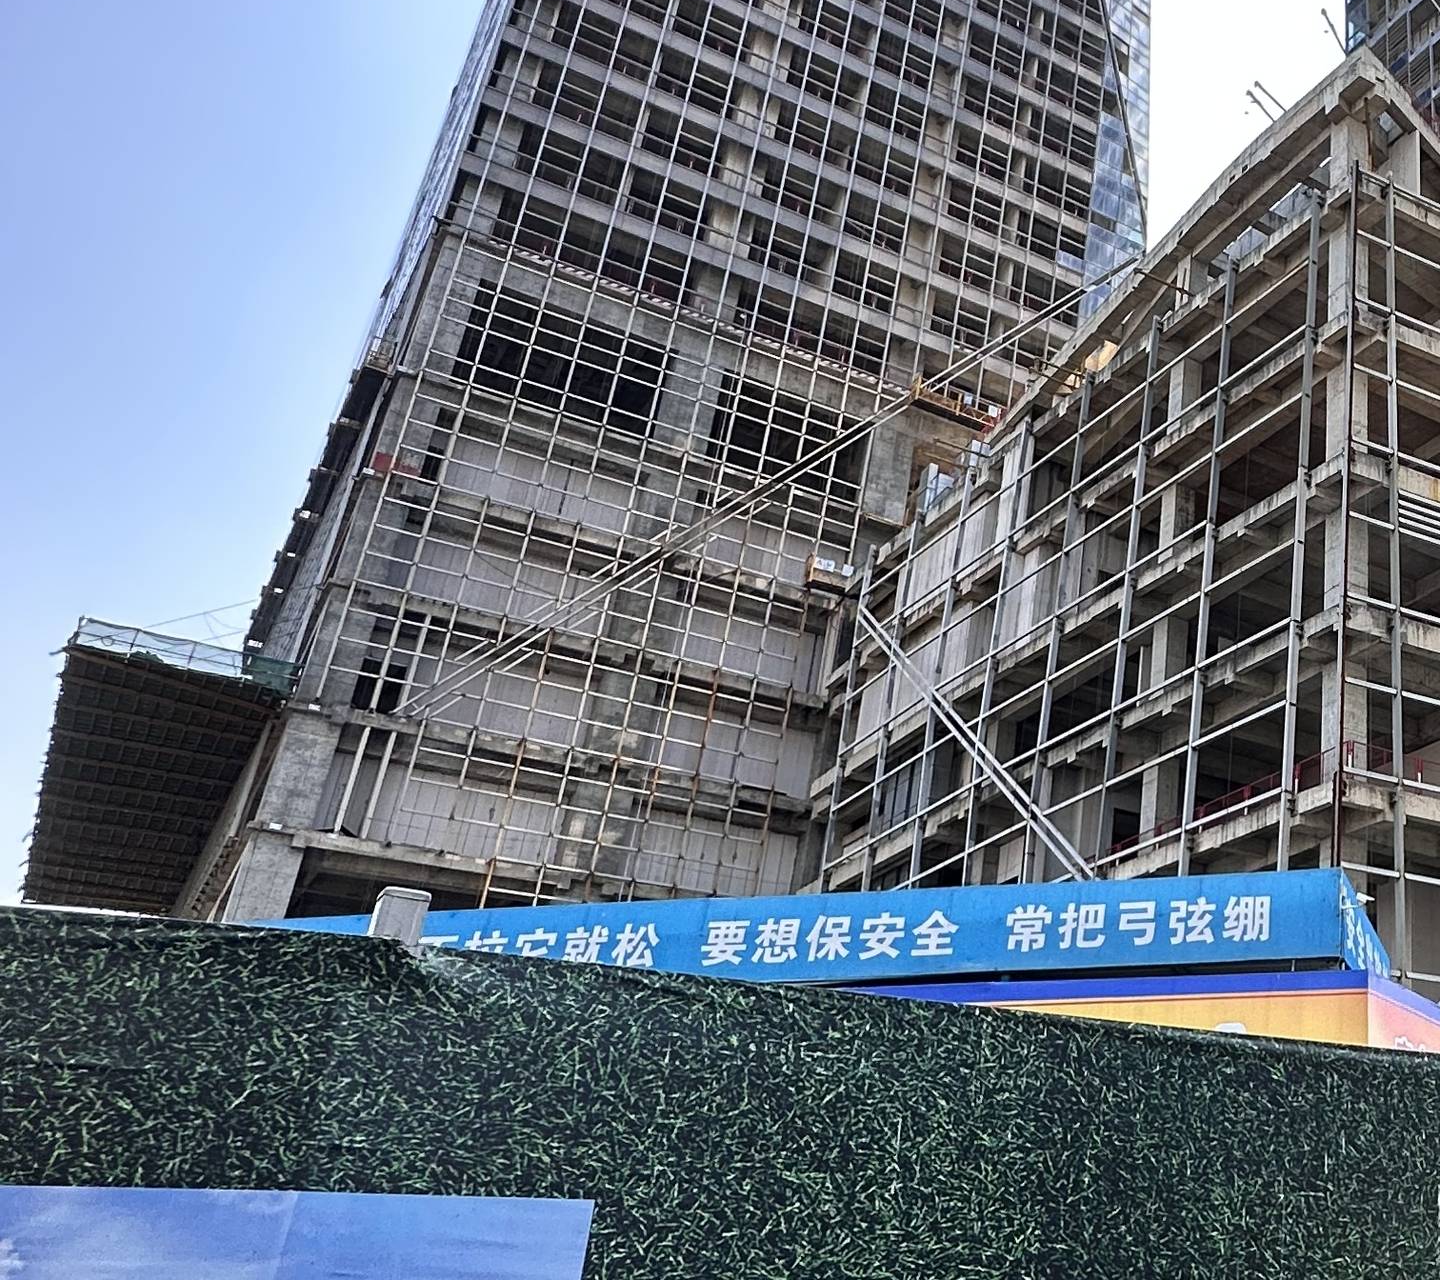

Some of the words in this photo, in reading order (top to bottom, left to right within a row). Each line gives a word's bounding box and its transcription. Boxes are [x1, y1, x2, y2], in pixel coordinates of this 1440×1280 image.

[700, 910, 960, 967] 要想保安全
[1005, 895, 1272, 953] 常把弓弦绷
